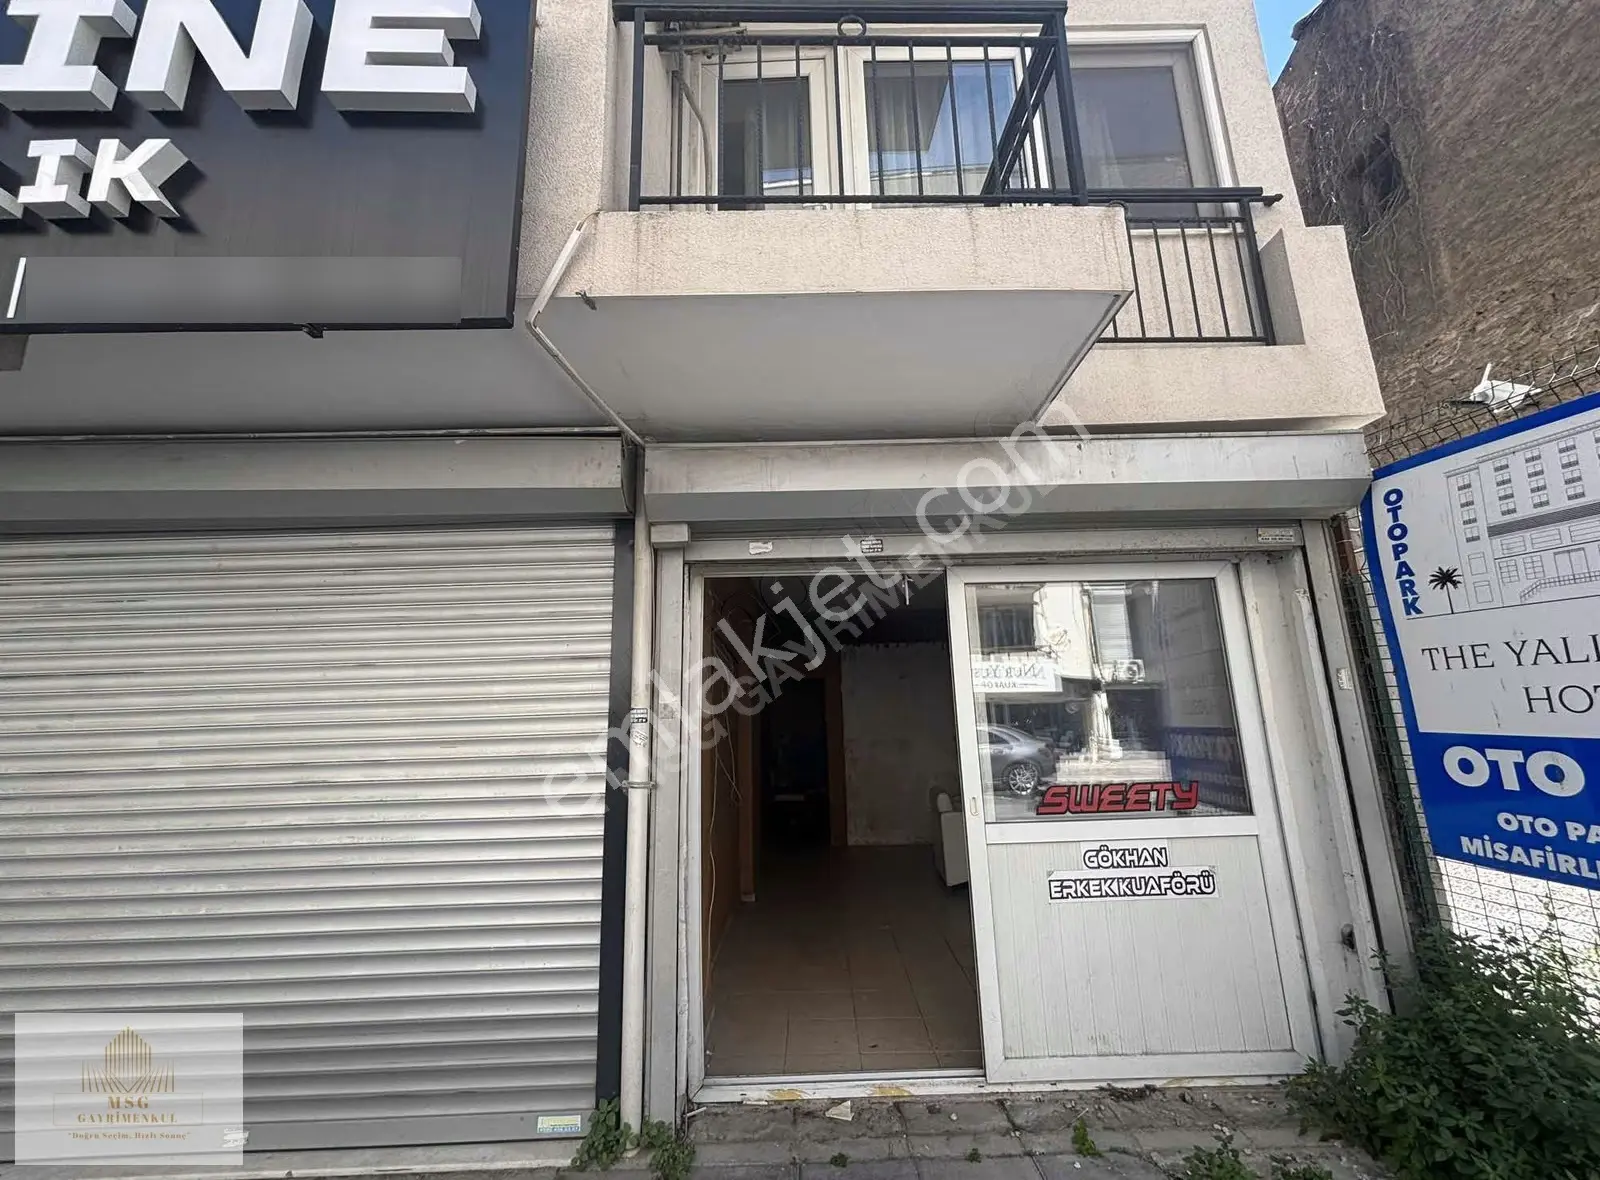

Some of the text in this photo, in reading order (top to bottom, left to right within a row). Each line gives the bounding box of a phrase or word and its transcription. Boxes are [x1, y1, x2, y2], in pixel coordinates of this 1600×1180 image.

[0, 0, 481, 112] INE
[0, 138, 188, 219] IK
[1383, 488, 1423, 616] OTOPARK
[1421, 643, 1495, 671] THE
[1523, 684, 1600, 713] HO
[1443, 746, 1585, 797] OTO
[1036, 781, 1198, 816] SWEETY
[1497, 812, 1558, 837] OTO
[1083, 844, 1168, 869] GÖKHAN
[1460, 834, 1600, 880] MİSAFİRL
